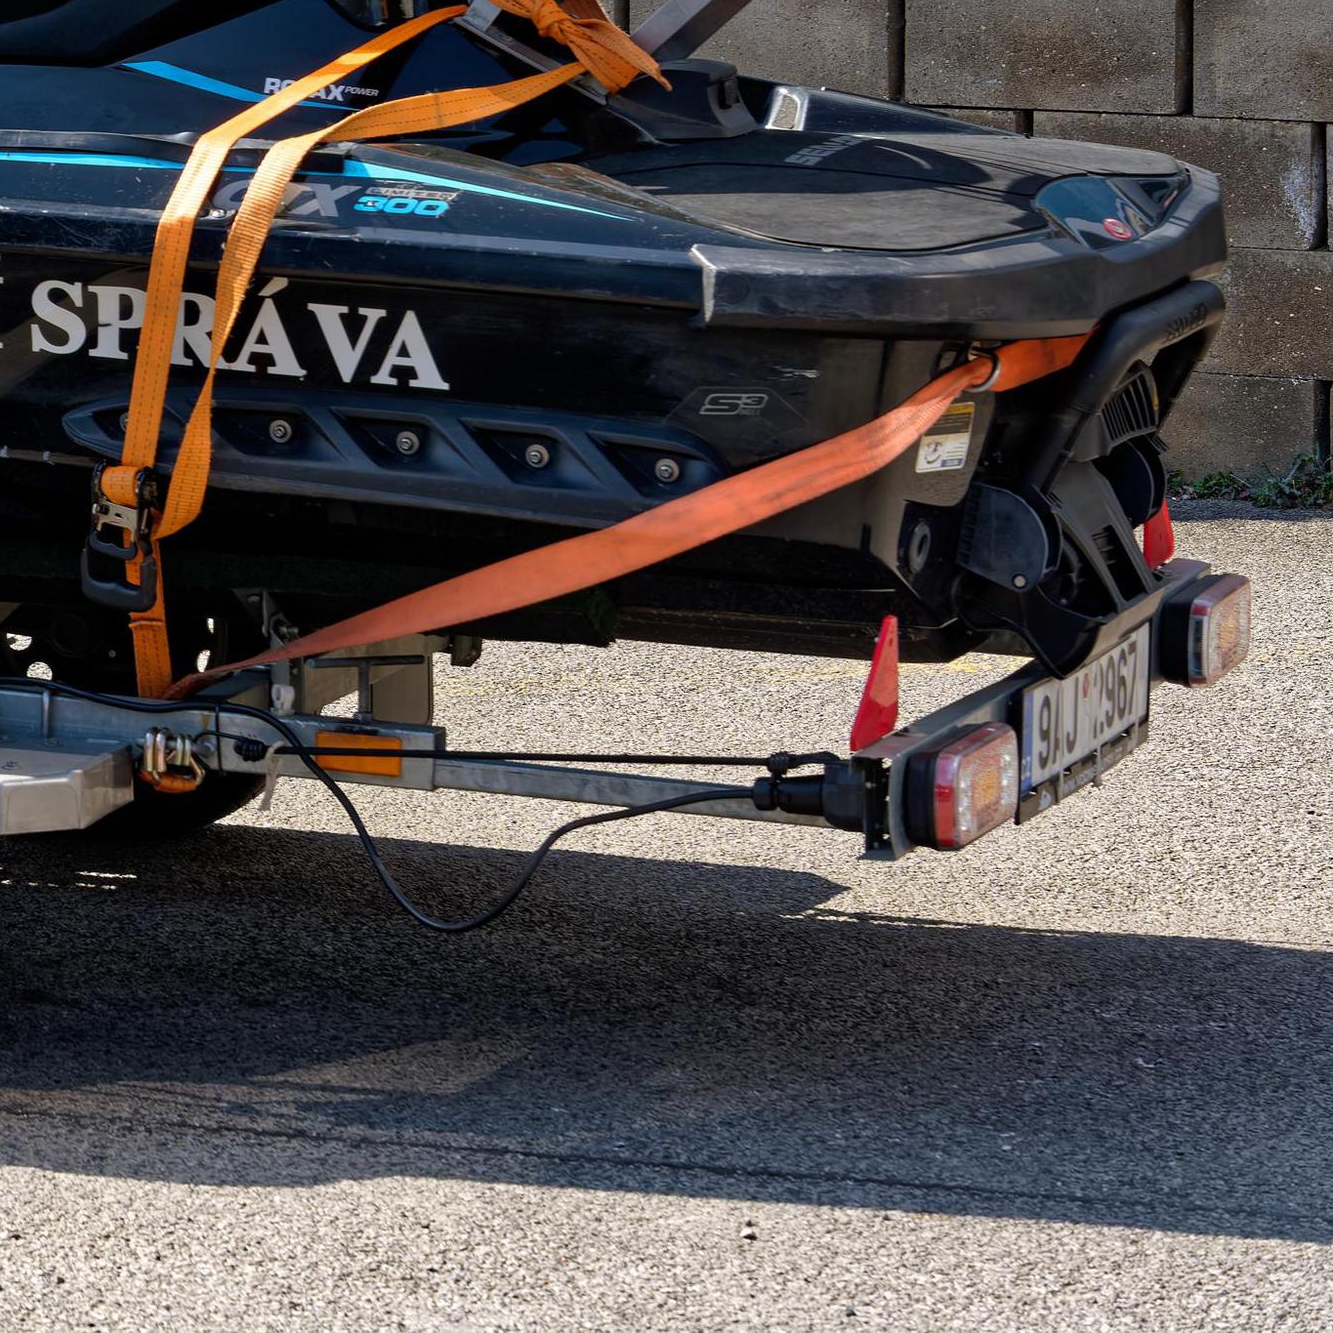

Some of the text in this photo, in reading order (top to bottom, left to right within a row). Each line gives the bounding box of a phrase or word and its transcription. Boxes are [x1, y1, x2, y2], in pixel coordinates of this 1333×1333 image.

[263, 77, 380, 102] RAX POWER
[353, 196, 449, 218] 300
[31, 276, 450, 391] SPRÁVA
[1039, 676, 1079, 771] 9AJ
